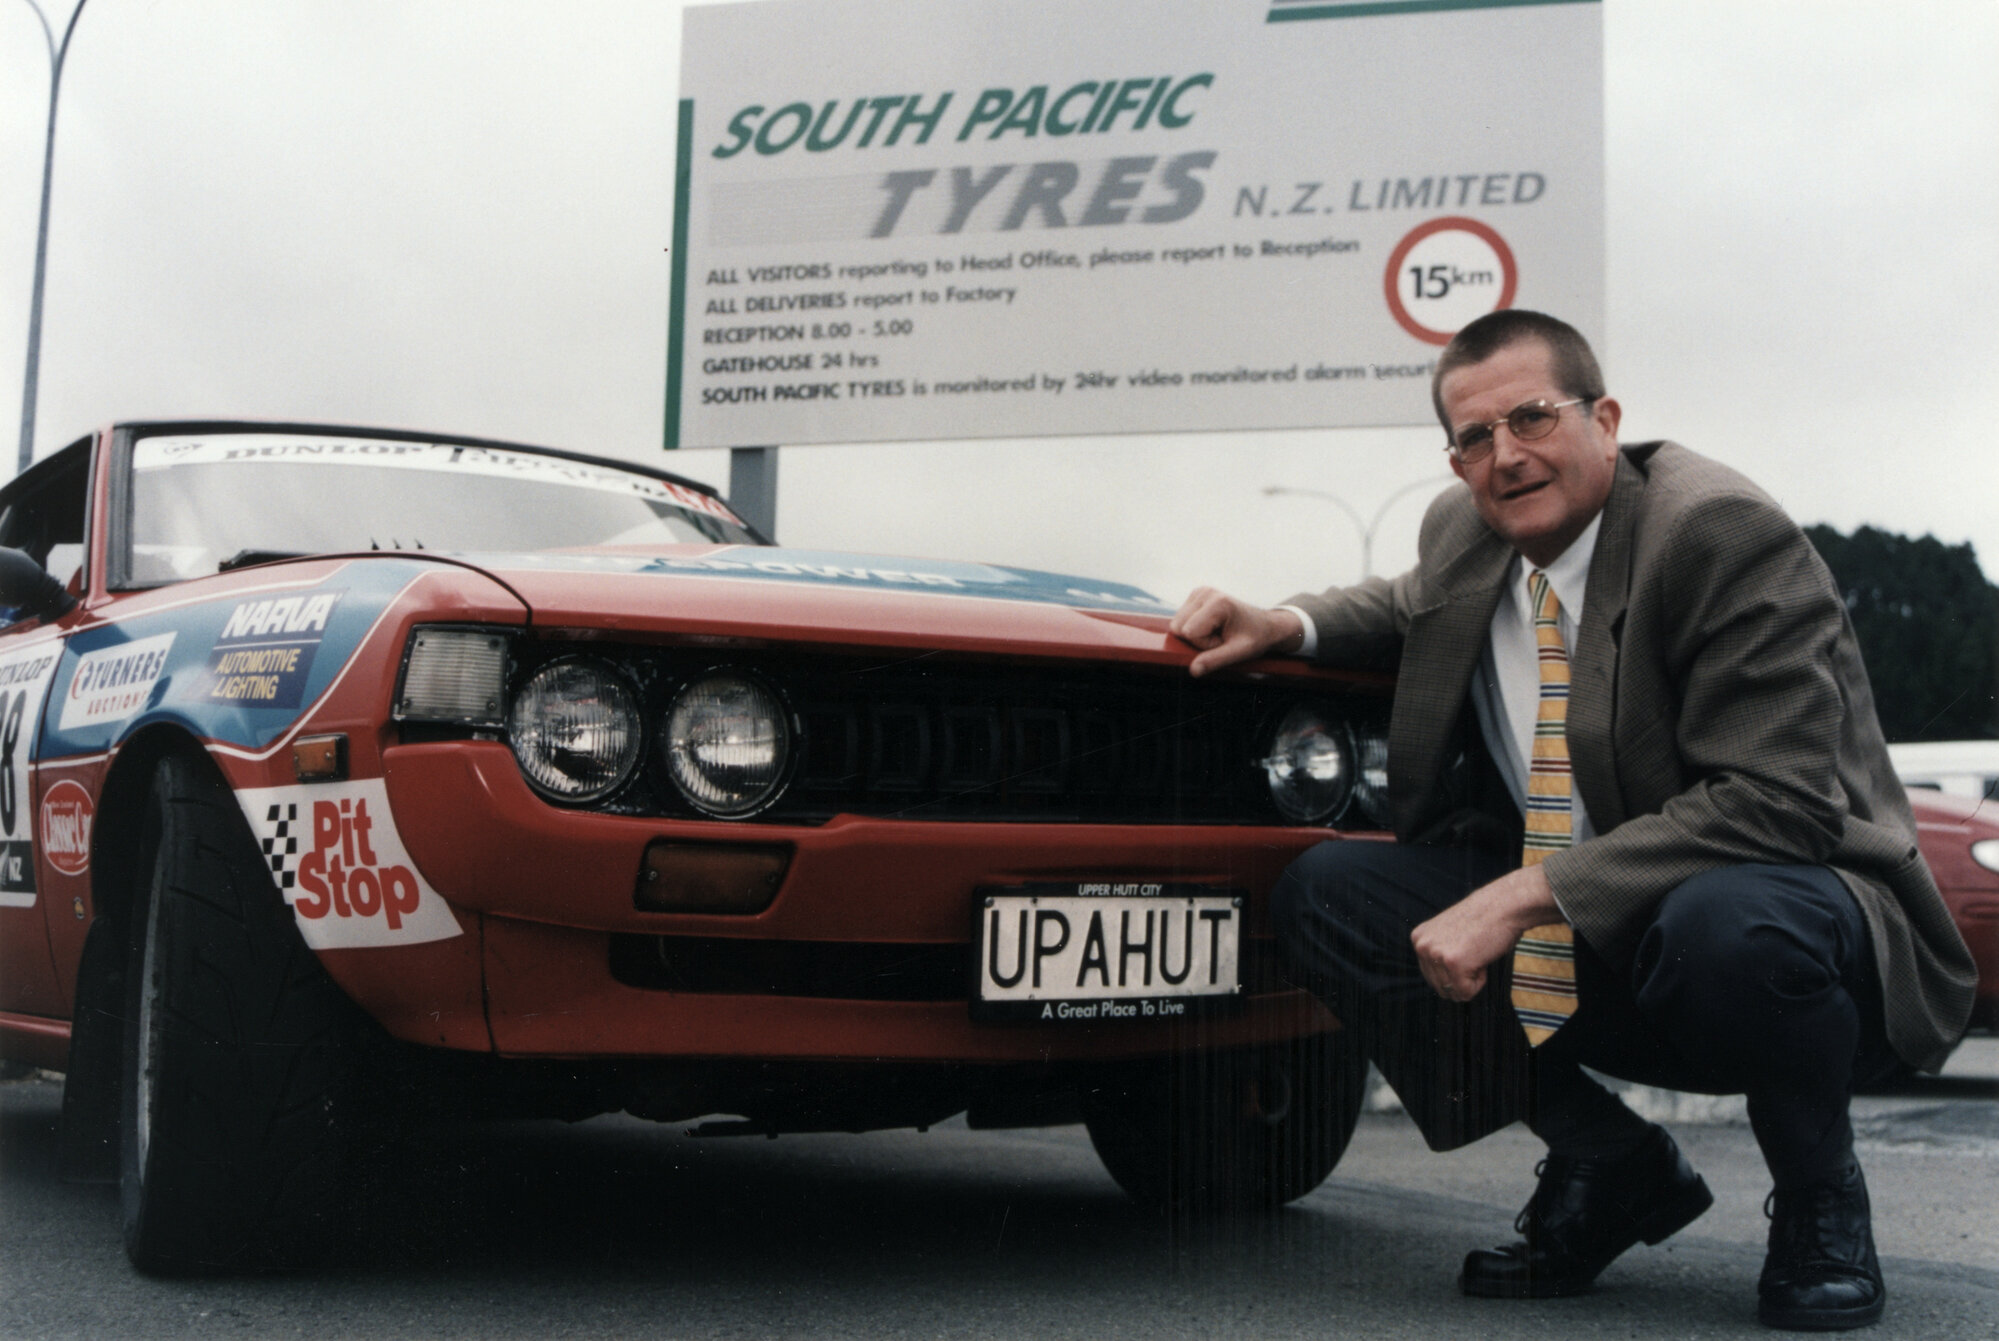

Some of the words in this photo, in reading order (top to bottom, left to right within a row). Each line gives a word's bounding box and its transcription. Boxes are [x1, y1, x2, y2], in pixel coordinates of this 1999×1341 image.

[712, 90, 954, 159] SOUTH
[955, 72, 1215, 142] PACIFIC
[868, 150, 1218, 239] TYRES
[1234, 181, 1333, 217] N.Z.
[1349, 171, 1546, 212] LIMITED
[706, 269, 738, 285] ALL
[748, 263, 831, 283] VISITORS
[839, 259, 928, 279] reporting
[935, 259, 953, 274] to
[961, 254, 1013, 272] Head
[1020, 249, 1081, 269] Office,
[1089, 245, 1153, 267] please
[1162, 243, 1226, 264] report
[1233, 244, 1253, 259] to
[1261, 236, 1360, 257] Reception
[705, 299, 737, 315] ALL
[745, 292, 846, 313] DELIVERIES
[853, 290, 913, 309] report
[920, 289, 940, 304] to
[946, 285, 1016, 304] Factory
[703, 325, 804, 345] RECEPTION
[811, 323, 851, 340] 8.00
[873, 319, 913, 336] 5.00
[702, 354, 813, 375] GATEHOUSE
[821, 354, 842, 369] 24
[849, 352, 879, 367] hrs
[702, 386, 767, 404] SOUTH
[773, 382, 839, 401] PACIFIC
[848, 379, 905, 396] TYRES
[912, 379, 928, 394] is
[934, 374, 1035, 394] monitored
[1043, 374, 1066, 393] by
[1075, 371, 1116, 389] 24hr
[1128, 367, 1183, 386] video
[1191, 364, 1297, 385] monitored
[1305, 362, 1366, 380] alarm
[220, 445, 423, 461] DUNLOP
[221, 594, 337, 638] NARVA
[91, 649, 166, 692] TURNERS
[215, 649, 301, 674] AUTOMOTIVE
[211, 675, 279, 700] LIGHTING
[313, 798, 377, 874] Pit
[8, 857, 22, 881] NZ
[296, 852, 420, 930] Stop
[1078, 884, 1110, 896] UPPER
[1113, 884, 1138, 896] HUTT
[1140, 884, 1162, 896] CITY
[1041, 1005, 1053, 1019] A
[1057, 1002, 1098, 1018] Great
[1101, 1000, 1136, 1017] Place
[1142, 1001, 1155, 1015] To
[1159, 999, 1184, 1014] Live
